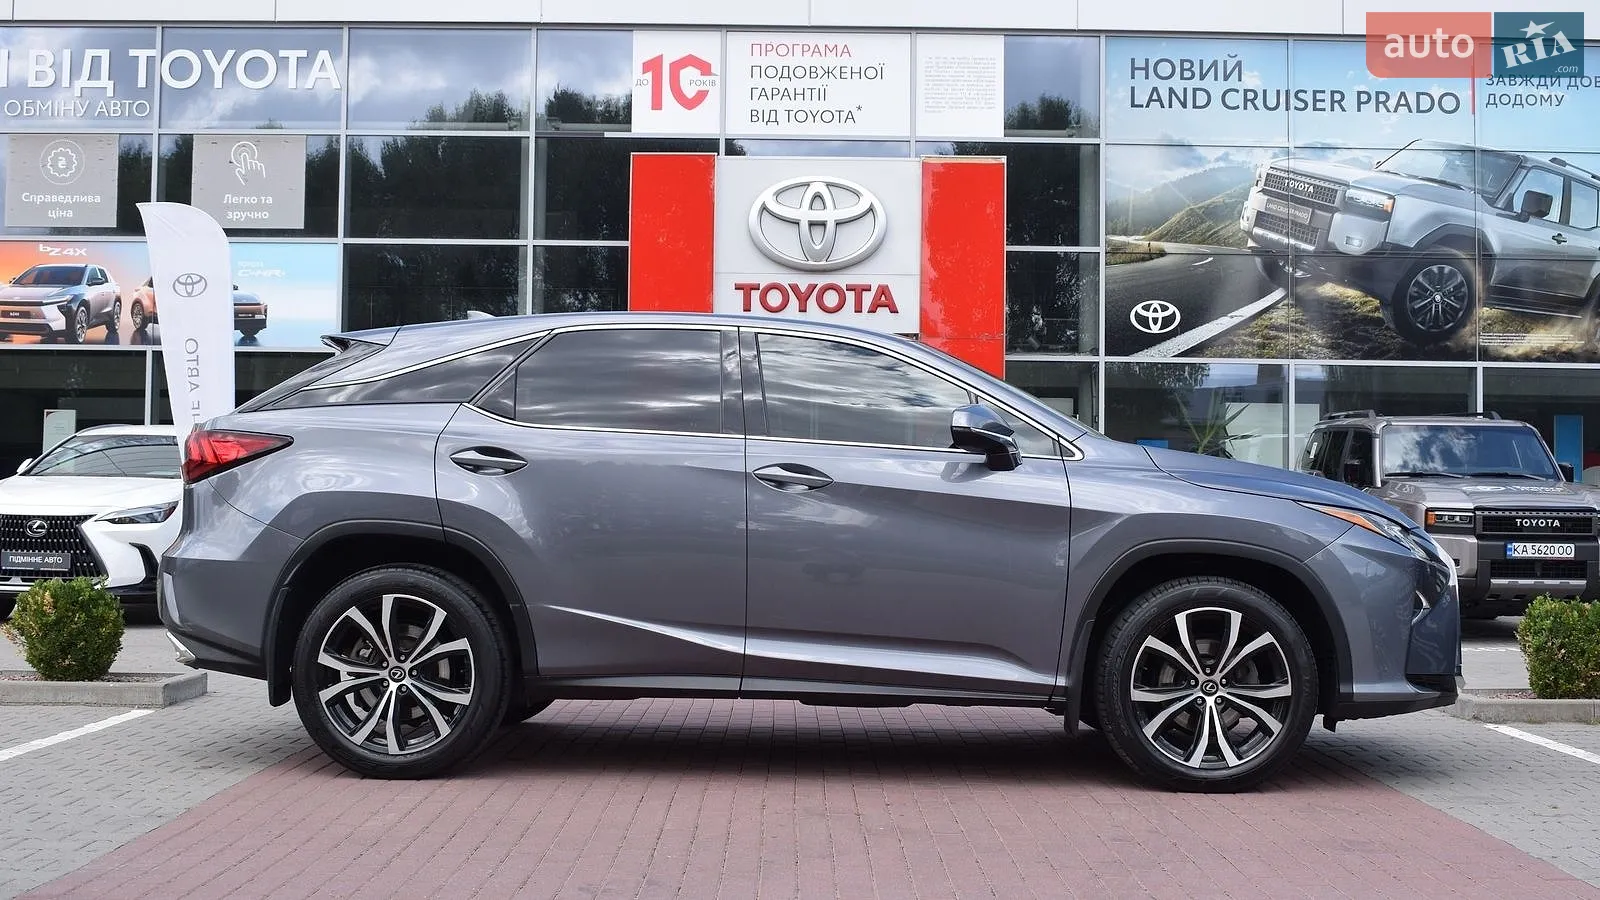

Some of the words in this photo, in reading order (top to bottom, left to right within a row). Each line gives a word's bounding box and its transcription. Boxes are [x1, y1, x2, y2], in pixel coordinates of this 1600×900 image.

[751, 43, 852, 57] ПРОГРАМА
[27, 48, 115, 98] ВІД
[129, 49, 342, 90] TOYOTA
[750, 63, 886, 82] ПОДОВЖЕНОЇ
[1130, 54, 1243, 82] НОВИЙ
[635, 79, 649, 87] ДО
[689, 79, 717, 87] РОКІВ
[1486, 73, 1561, 90] ЗАВЖДИ
[750, 84, 828, 101] ГАРАНТІЇ
[1130, 86, 1212, 109] LAND
[1221, 88, 1346, 112] CRUISER
[1356, 90, 1461, 114] PRADO
[1486, 93, 1565, 108] ДОДОМУ
[4, 99, 90, 118] ОБМІНУ
[95, 100, 151, 118] АВТО
[750, 109, 779, 126] ВІД
[1284, 180, 1314, 193] TOYOTA
[22, 192, 101, 205] Справедлива
[223, 194, 258, 204] Легко
[260, 196, 273, 204] та
[48, 207, 73, 219] ціна
[227, 211, 269, 221] зручно
[734, 282, 899, 314] TOYOTA
[1516, 519, 1560, 527] TOYOTA
[1513, 544, 1529, 555] KA
[1531, 544, 1556, 556] 5620
[9, 555, 43, 564] ПІДМІННЕ
[44, 556, 63, 564] АВТО
